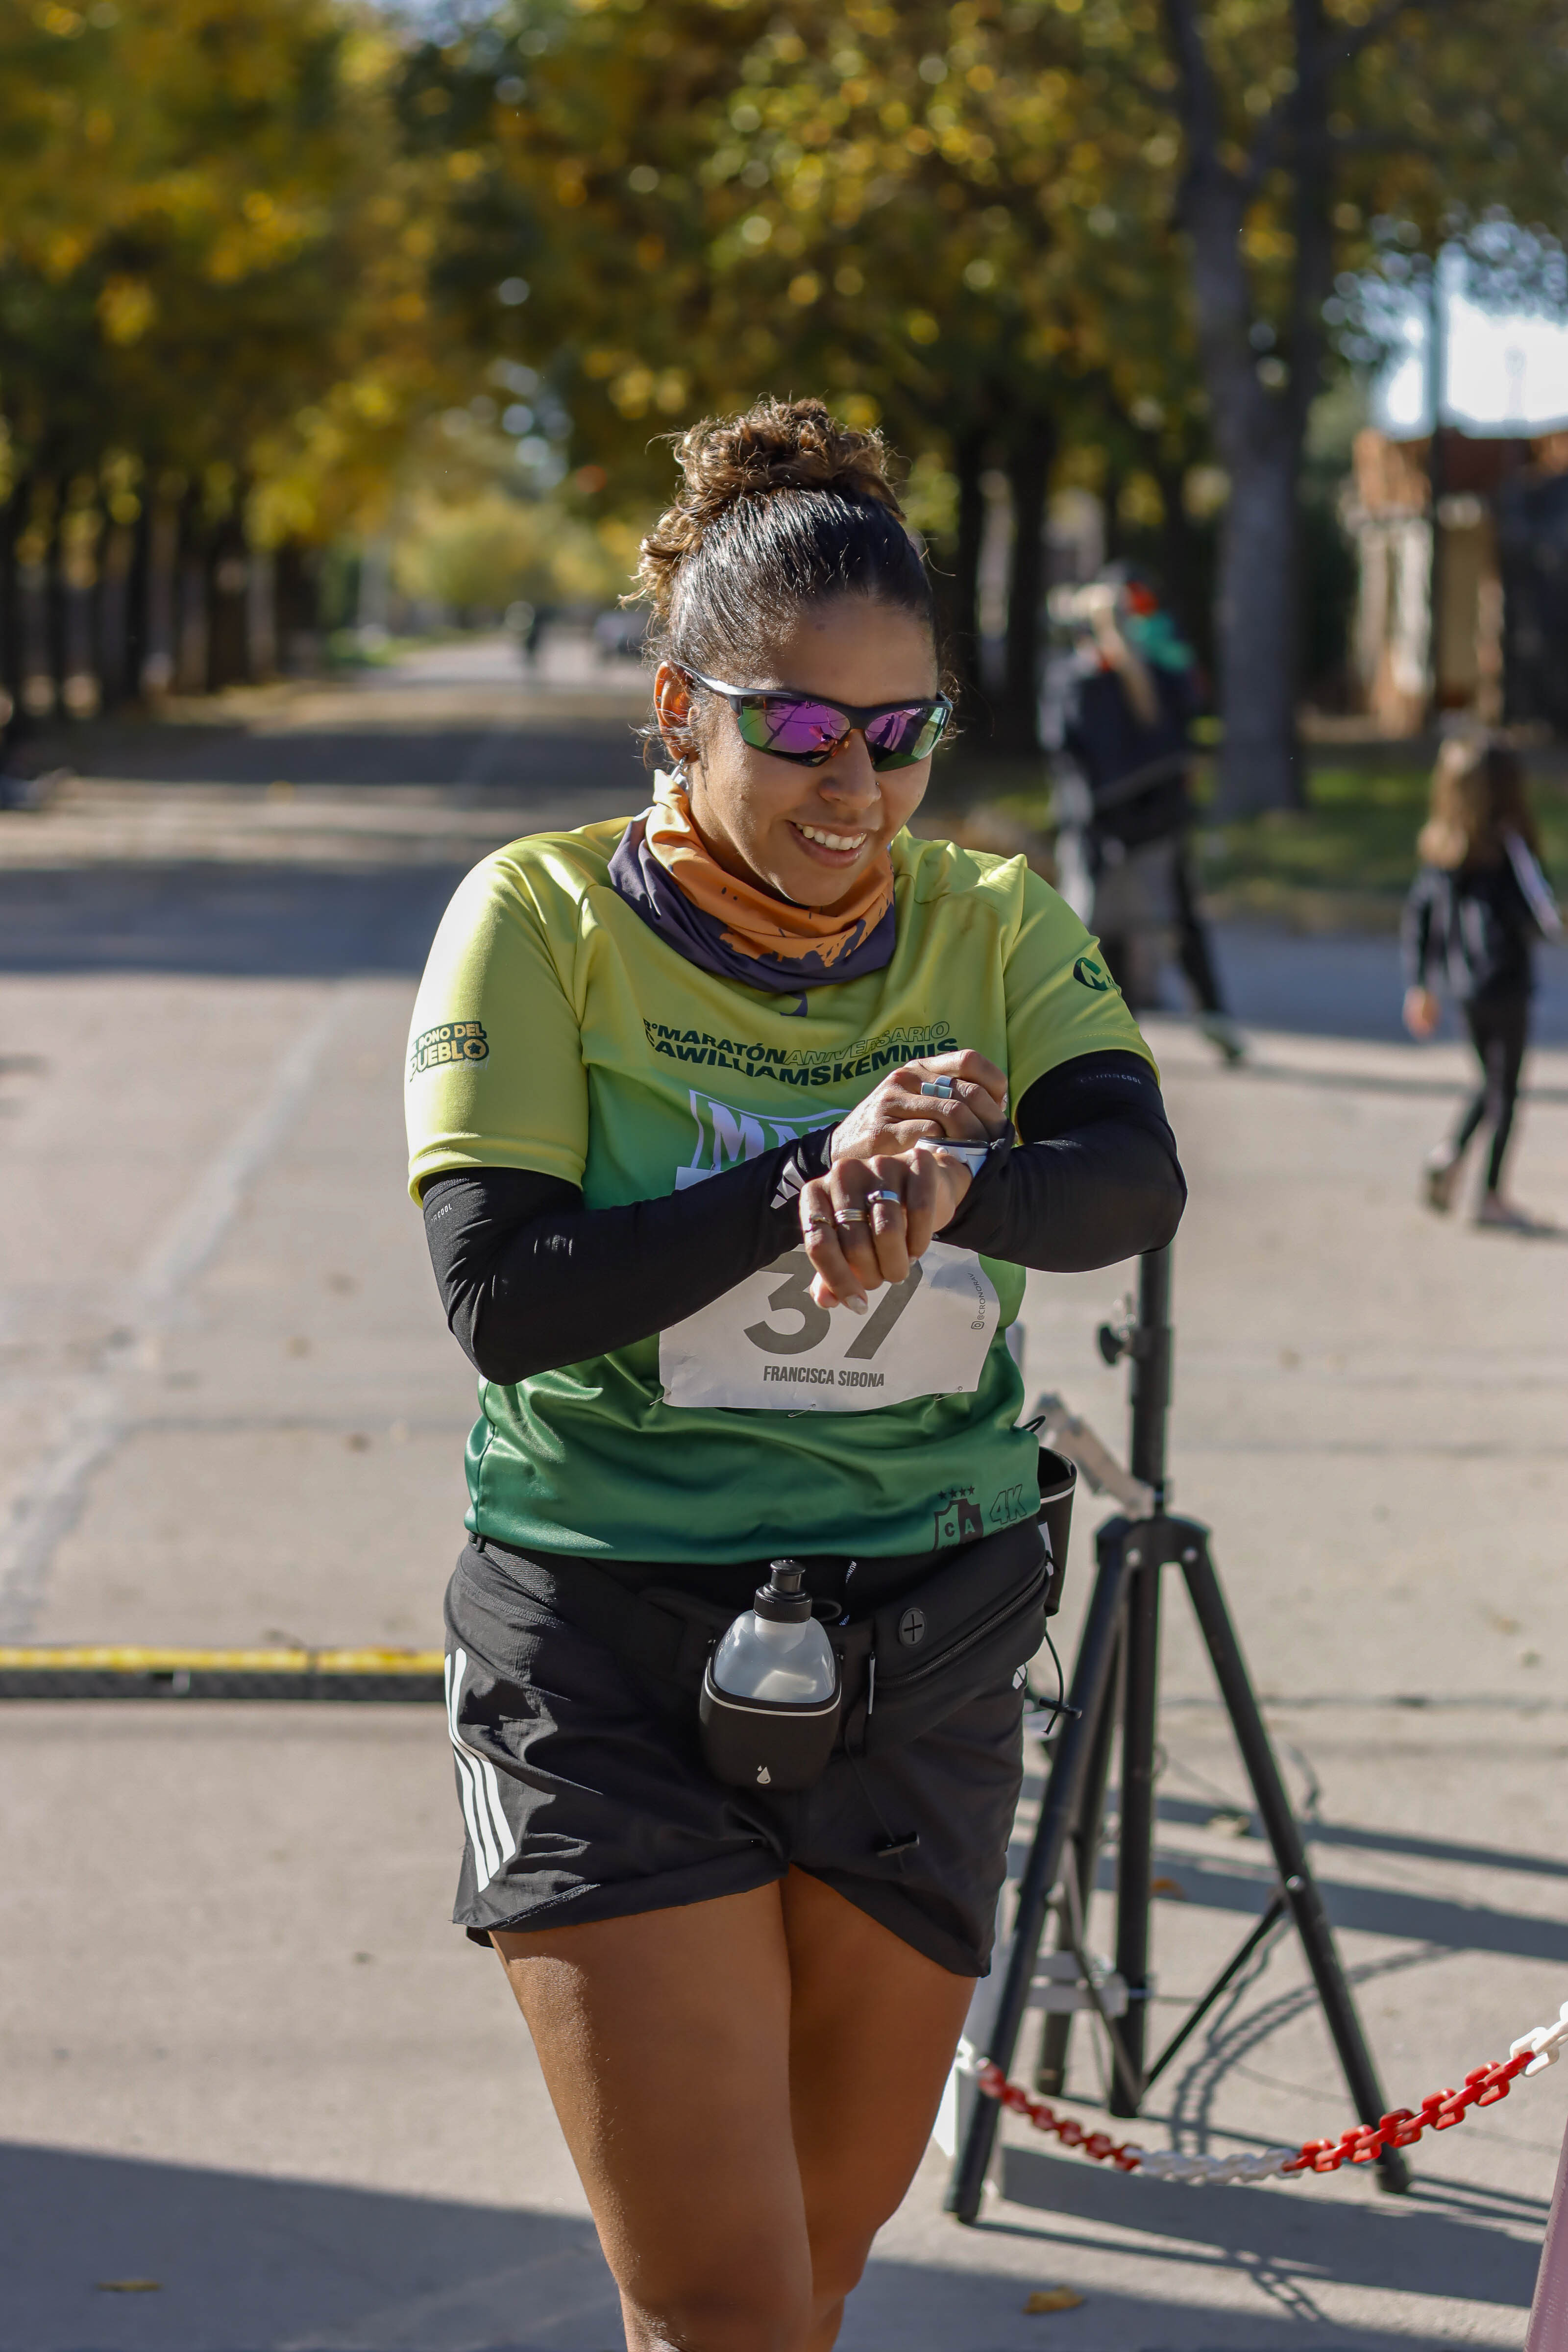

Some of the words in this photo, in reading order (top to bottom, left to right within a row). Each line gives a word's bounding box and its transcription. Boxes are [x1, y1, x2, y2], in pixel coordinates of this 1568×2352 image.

[418, 1027, 451, 1051] BONO
[454, 1023, 485, 1038] DEL
[411, 1038, 487, 1079] PUEBLO
[763, 1365, 834, 1385] FRANCISCA
[837, 1370, 884, 1388] SIBONA
[989, 1484, 1027, 1525] 4K
